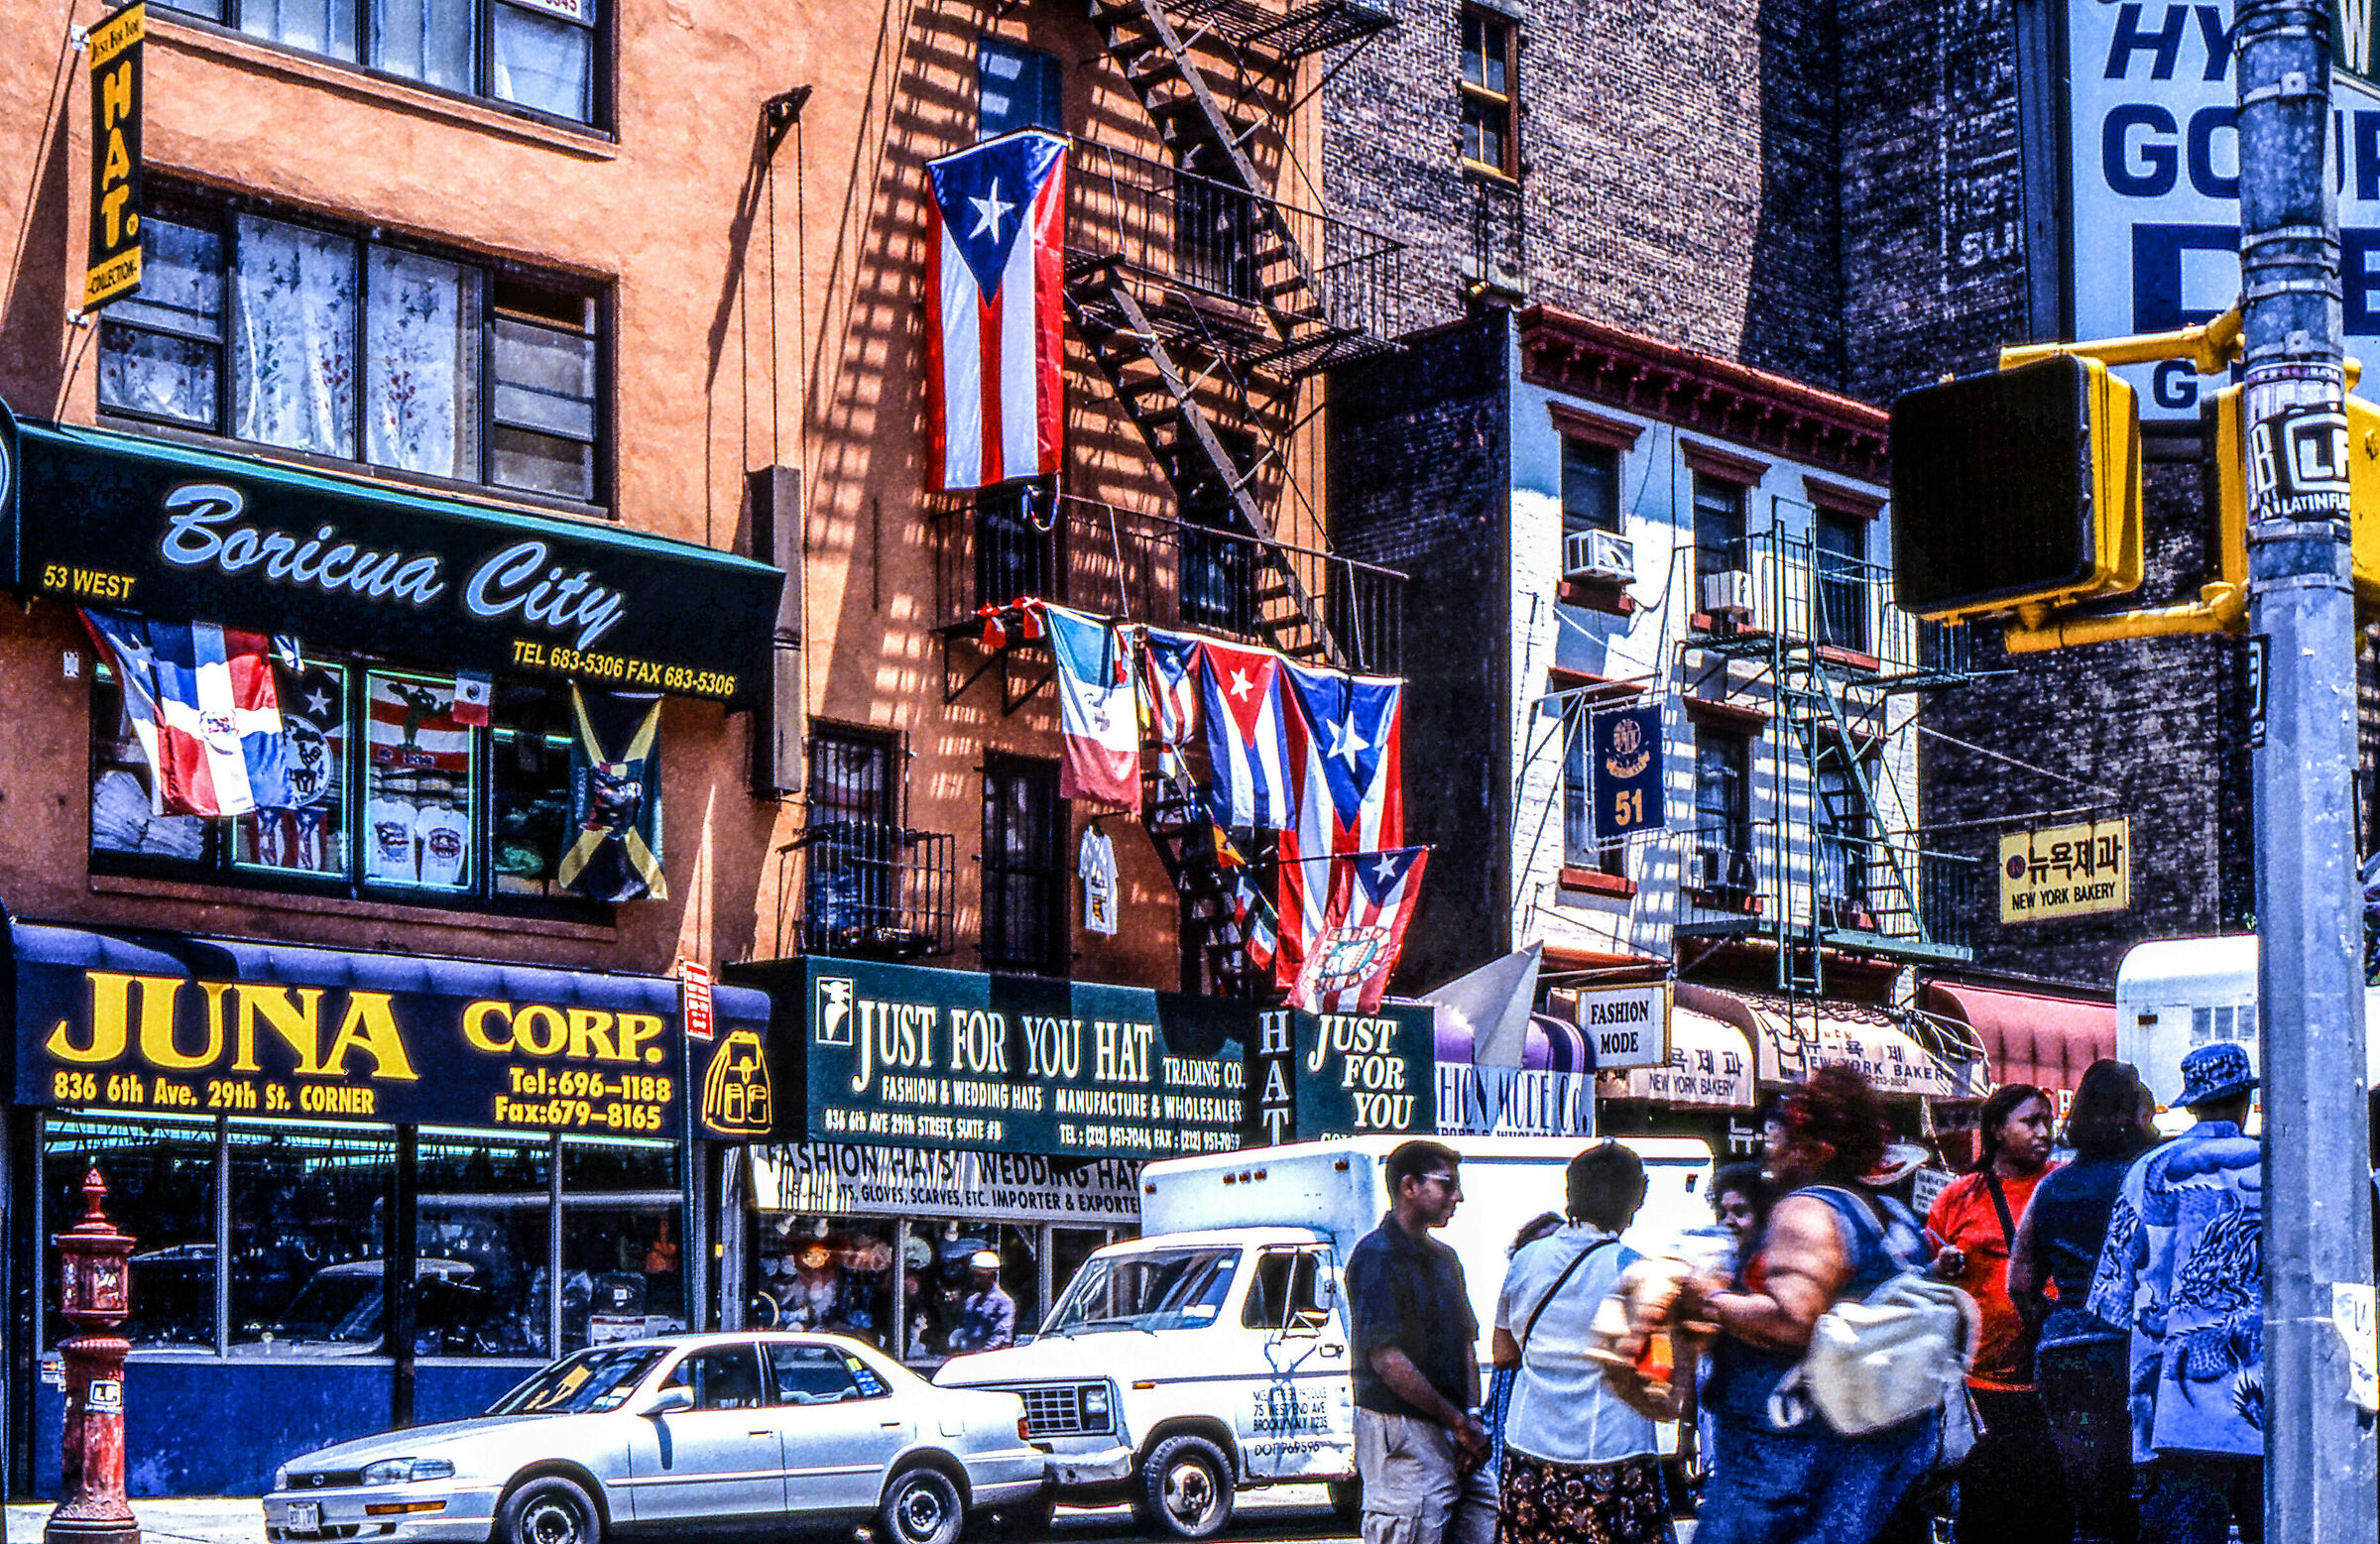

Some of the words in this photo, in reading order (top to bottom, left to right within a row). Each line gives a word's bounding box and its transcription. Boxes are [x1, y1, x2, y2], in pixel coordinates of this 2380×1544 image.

[43, 564, 68, 588] 53
[73, 568, 136, 599] WEST
[161, 482, 445, 605] Boricua
[465, 540, 625, 652] City
[513, 640, 546, 666] TEL
[549, 648, 625, 678] 683-5306
[626, 659, 663, 685] FAX
[663, 665, 737, 696] 683-5306
[1614, 787, 1644, 827] 51
[2028, 833, 2123, 886] 뉴욕제과
[2011, 891, 2037, 911] NEW
[2039, 888, 2071, 907] YORK
[2074, 881, 2116, 903] BAKERY
[45, 970, 420, 1081] JUNA
[462, 1000, 664, 1064] CORP.
[1590, 1000, 1650, 1025] FASHION
[851, 999, 937, 1093] JUST
[949, 1008, 1010, 1075] FOR
[1020, 1014, 1083, 1080] YOU
[1093, 1020, 1154, 1083] HAT
[1161, 1057, 1221, 1089] TRADING
[1307, 1014, 1398, 1073] JUST
[1599, 1031, 1639, 1054] MODE
[54, 1070, 98, 1102] 836
[106, 1073, 145, 1105] 6th
[153, 1076, 199, 1108] Ave.
[207, 1079, 258, 1110] 29th
[265, 1083, 292, 1112] St.
[298, 1083, 377, 1115] CORNER
[1341, 1054, 1406, 1091] FOR
[1649, 1073, 1671, 1092] NEW
[1672, 1075, 1698, 1096] YORK
[1700, 1077, 1735, 1097] BAKERY
[881, 1075, 938, 1105] FASHION
[939, 1078, 950, 1106] &
[952, 1080, 1010, 1110] WEDDING
[1012, 1085, 1043, 1112] HATS
[1054, 1088, 1147, 1119] MANUFACTURE
[1150, 1094, 1161, 1120] &
[1352, 1091, 1416, 1130] YOU
[1497, 1070, 1551, 1129] MODE
[824, 1108, 846, 1131] 836
[848, 1110, 868, 1132] 6th
[869, 1111, 890, 1134] AVE
[890, 1113, 916, 1135] 29th
[955, 1118, 985, 1140] SUITE
[861, 1184, 908, 1206] GLOVES,
[910, 1187, 964, 1209] SCARVES,
[965, 1191, 990, 1207] ETC.
[992, 1189, 1062, 1211] IMPORTER
[1065, 1193, 1075, 1211] &
[1253, 1442, 1278, 1457] DOT
